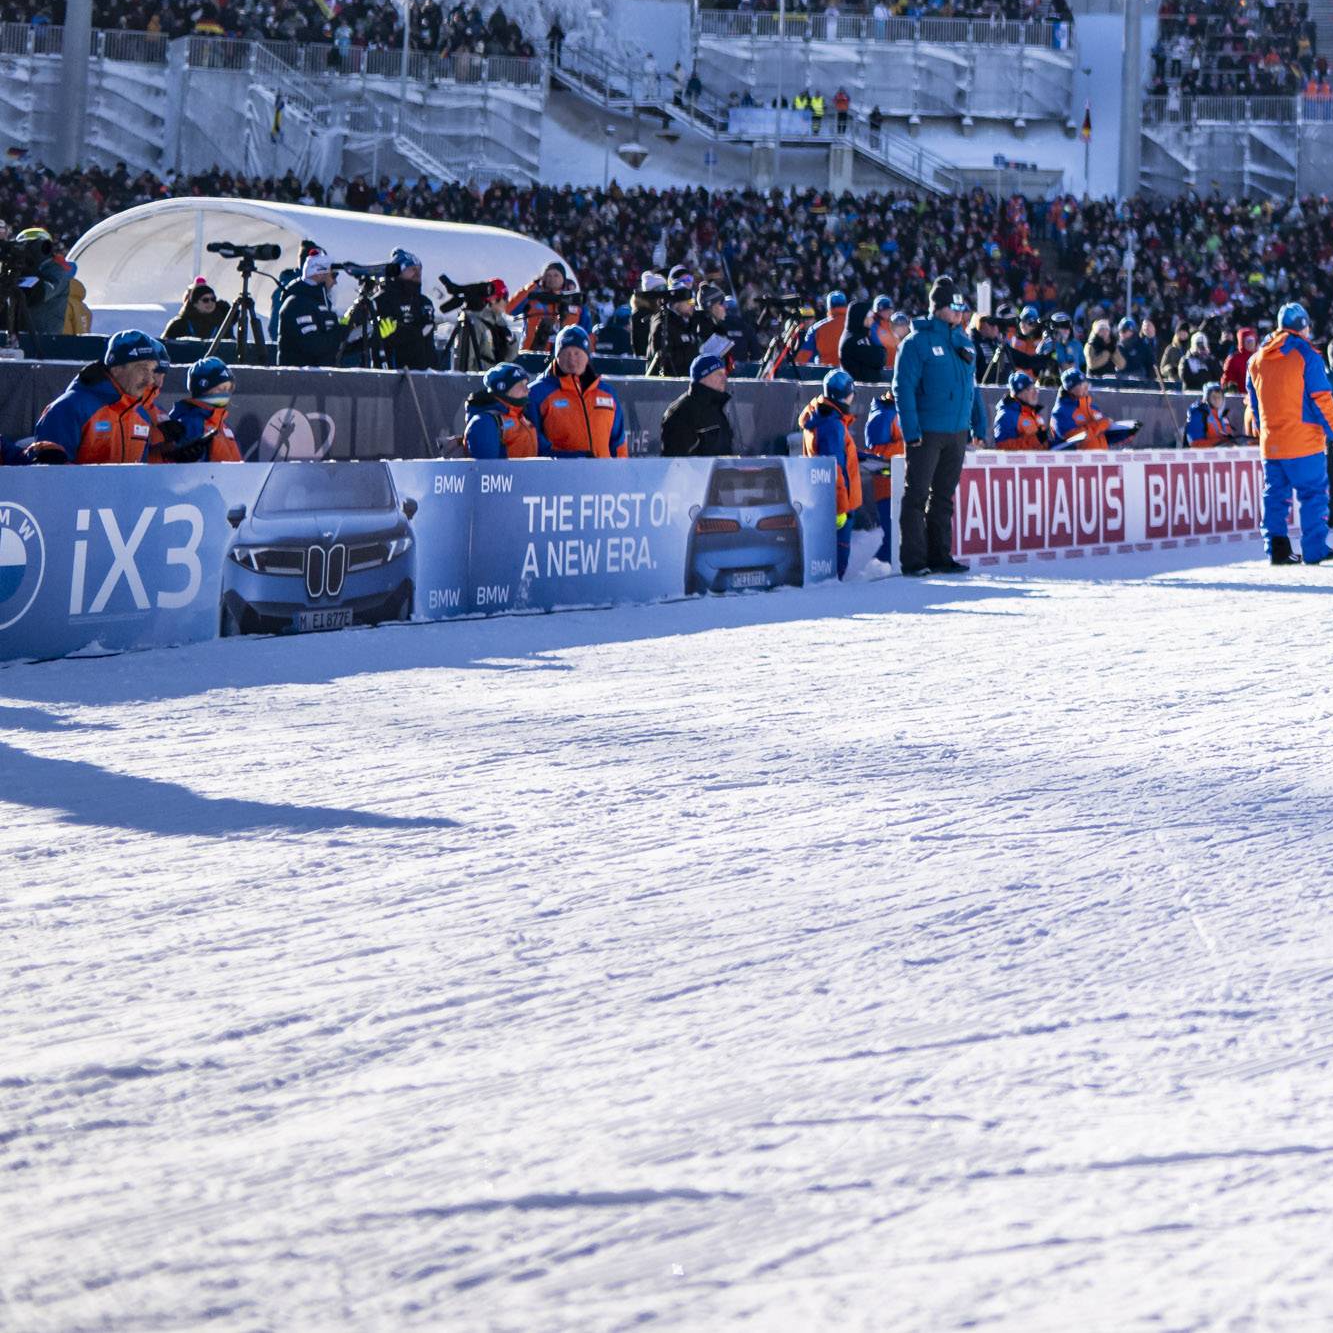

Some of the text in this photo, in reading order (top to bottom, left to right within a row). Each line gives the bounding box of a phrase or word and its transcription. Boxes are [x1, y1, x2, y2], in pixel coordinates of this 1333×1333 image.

[434, 475, 466, 495] BMW
[480, 474, 513, 494] BMW
[811, 469, 831, 485] BMW
[951, 476, 1123, 542] AUHAUS
[1147, 470, 1265, 528] BAUHA
[522, 492, 680, 534] THE FIRST OF
[69, 503, 205, 615] iX3
[521, 535, 657, 580] A NEW ERA.
[811, 560, 832, 576] BMW
[428, 587, 461, 610] BMW
[476, 585, 510, 606] BMW
